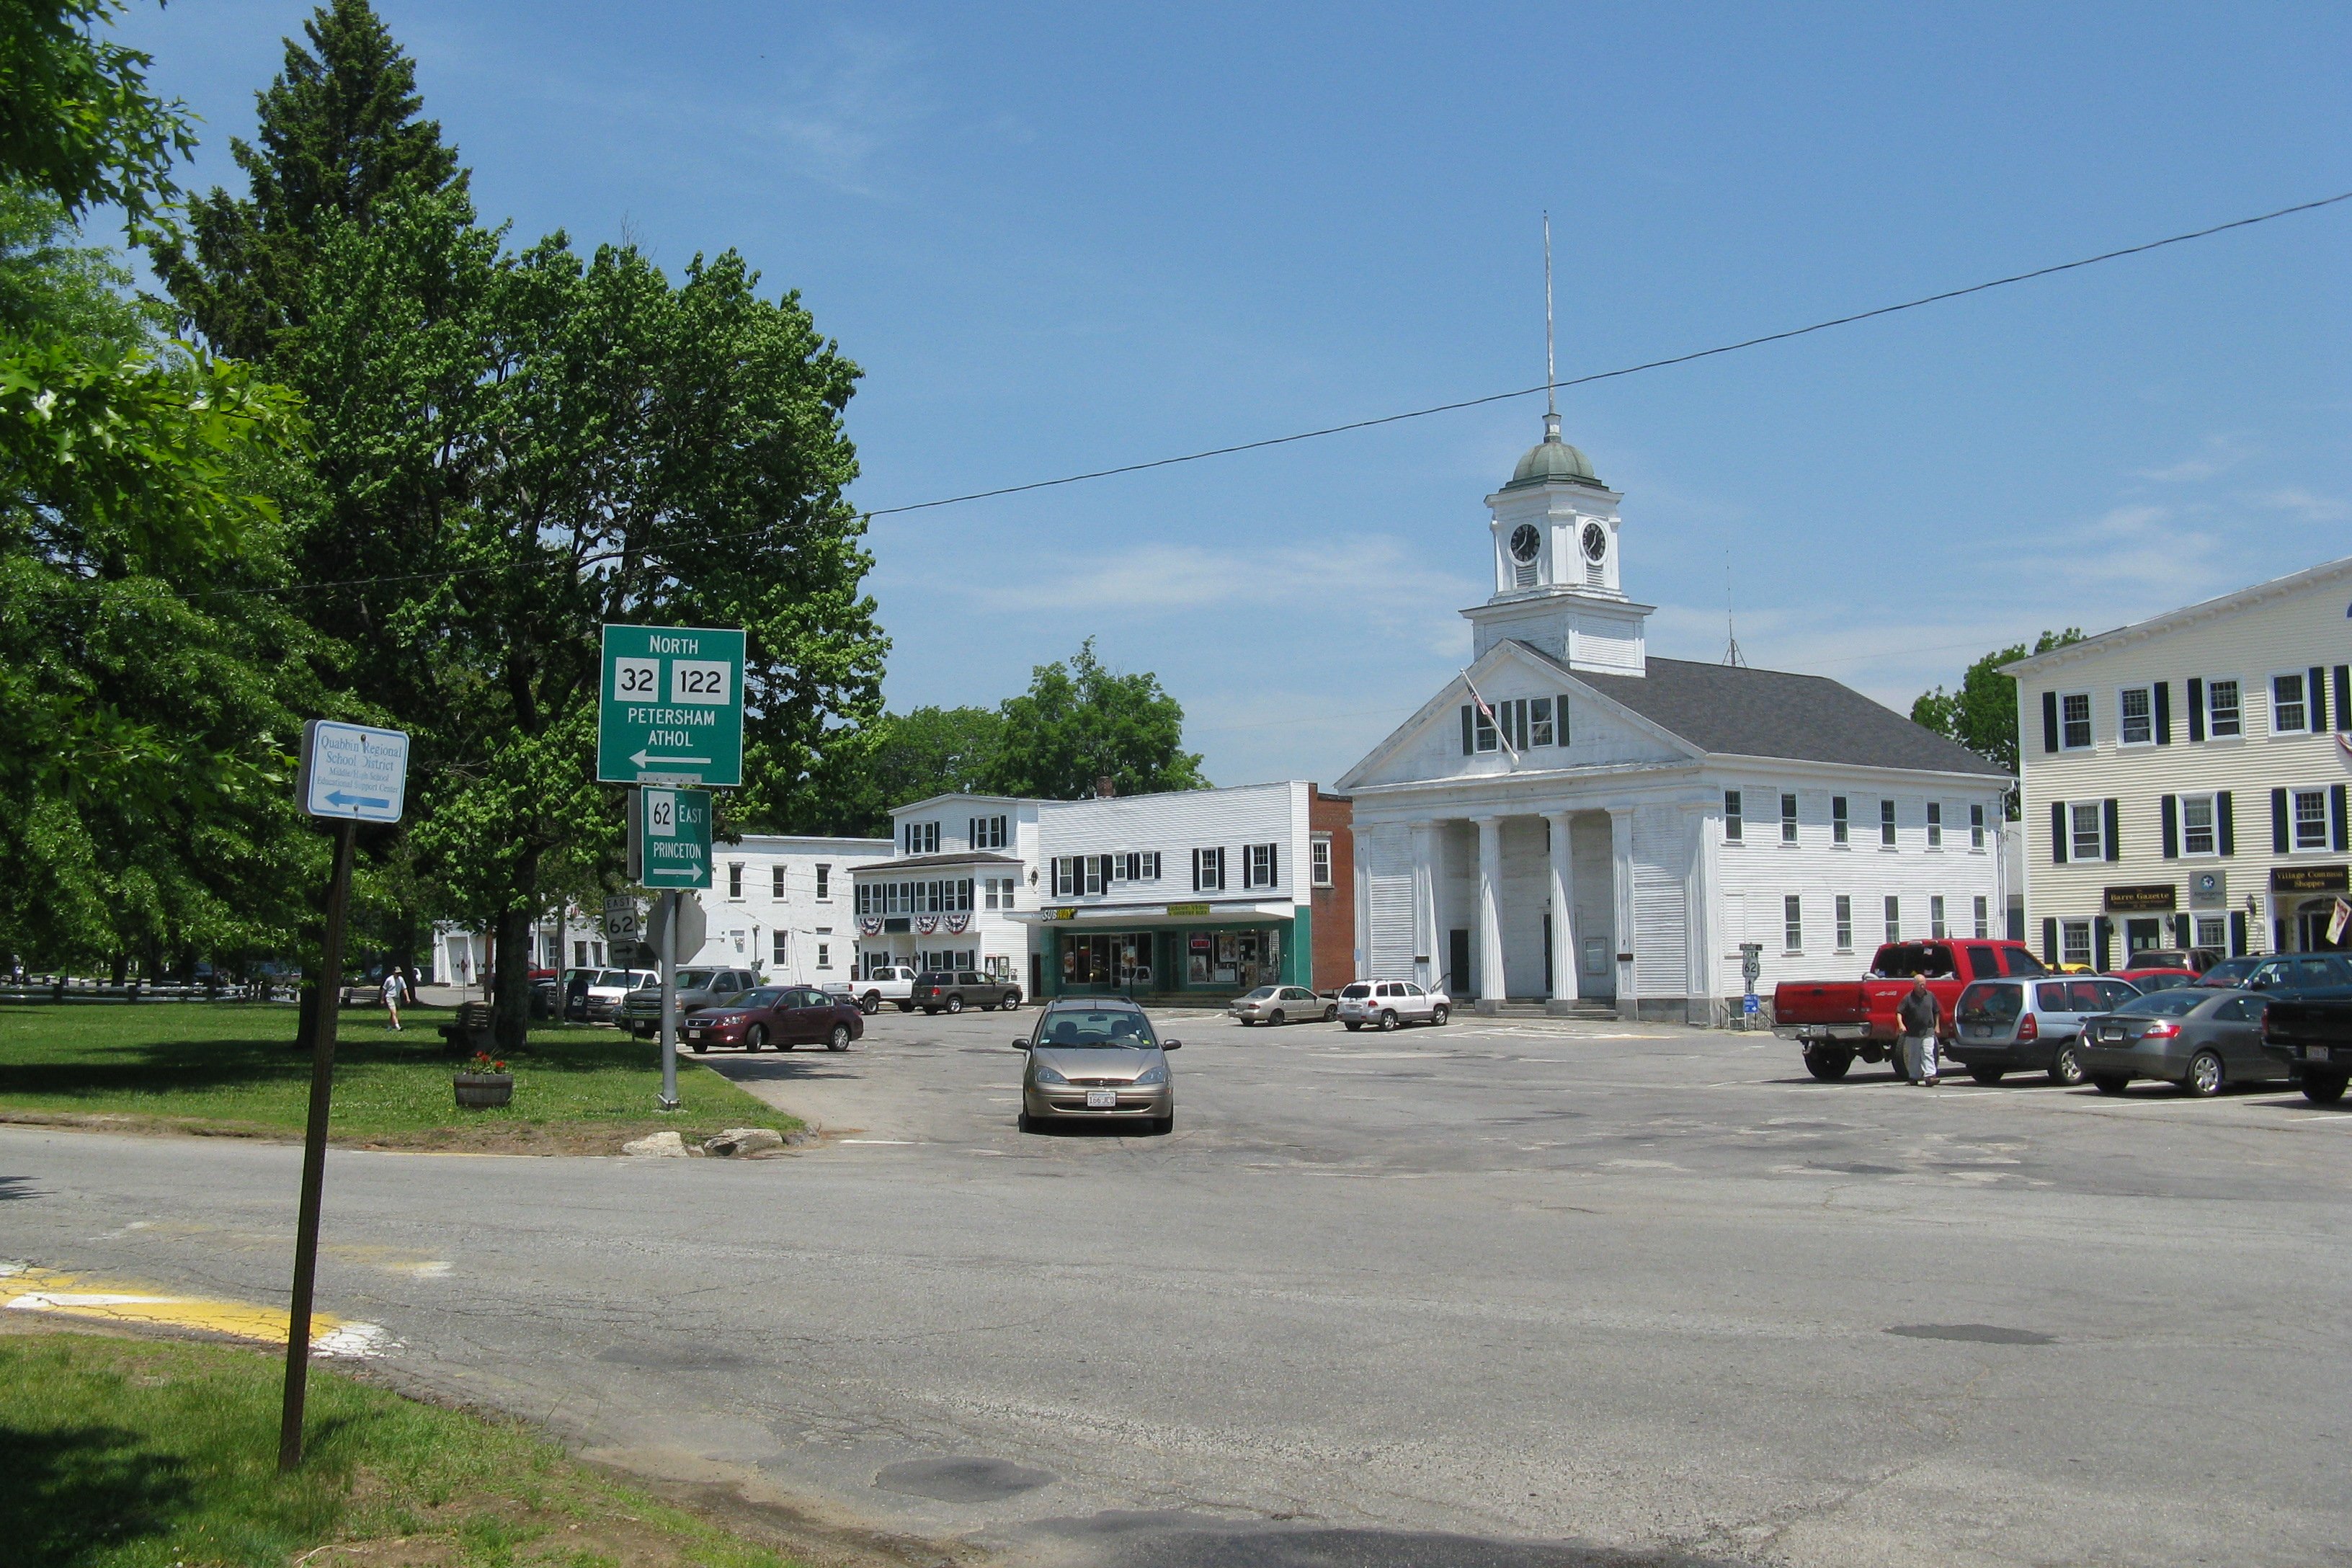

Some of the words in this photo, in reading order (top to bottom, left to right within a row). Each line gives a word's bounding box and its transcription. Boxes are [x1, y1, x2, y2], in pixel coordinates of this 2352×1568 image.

[649, 635, 698, 655] NORTH
[620, 668, 654, 692] 32
[680, 670, 721, 694] 122
[628, 707, 715, 726] PETERSHAM
[321, 735, 359, 752] Quabbin
[363, 741, 401, 758] Regional
[648, 730, 694, 747] ATHOL
[326, 751, 357, 767] School
[363, 755, 393, 771] District
[654, 802, 671, 825] 62
[679, 805, 702, 824] EAST
[654, 842, 702, 859] PRINCETON
[607, 898, 630, 907] EAST
[1042, 908, 1077, 921] SUBWAY
[610, 917, 633, 934] 62
[1745, 962, 1757, 973] 62
